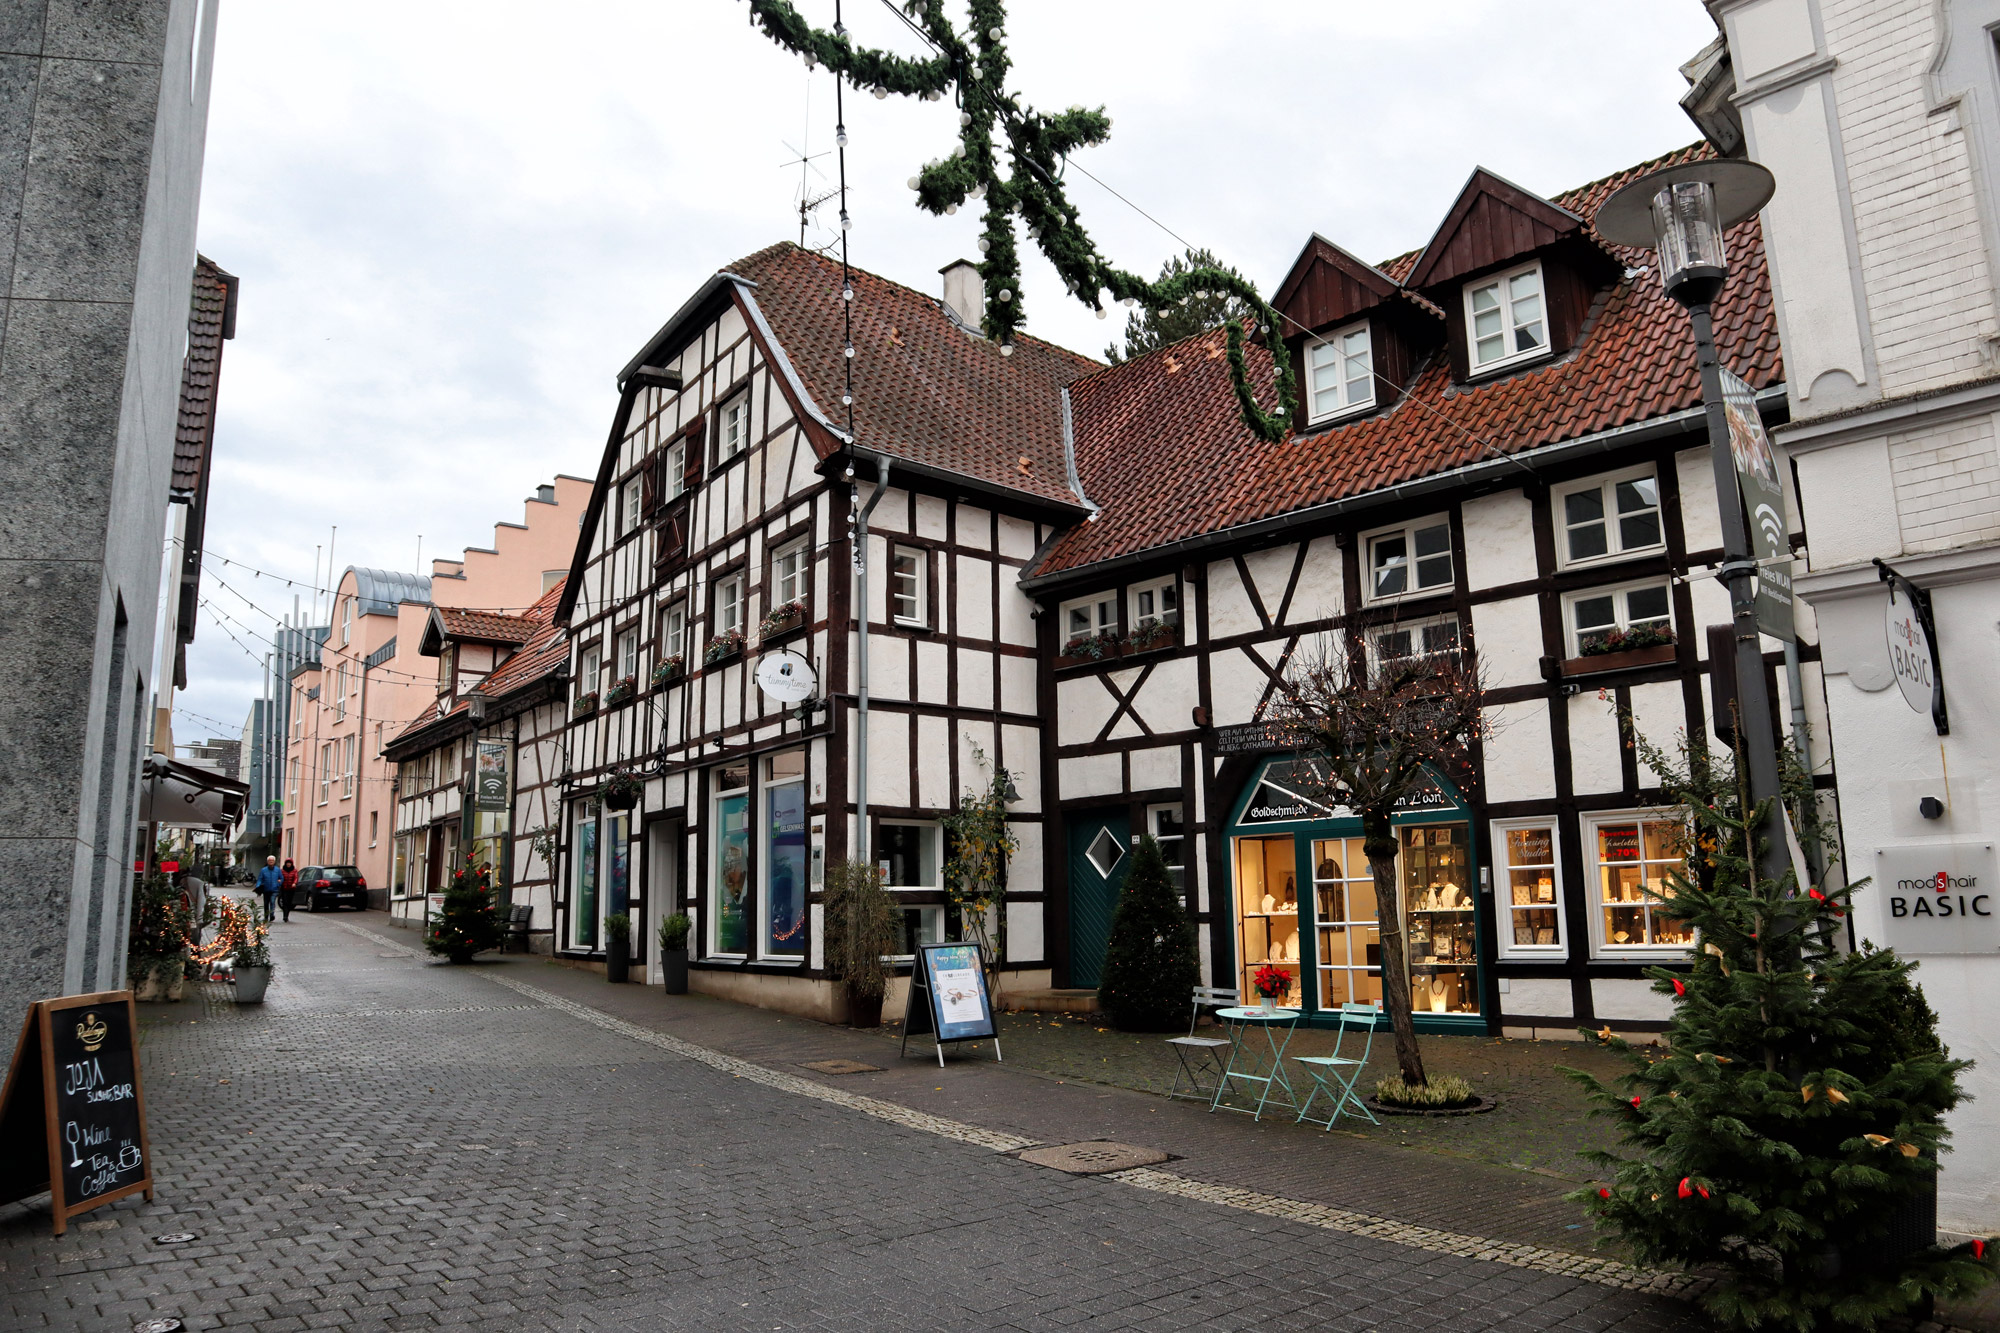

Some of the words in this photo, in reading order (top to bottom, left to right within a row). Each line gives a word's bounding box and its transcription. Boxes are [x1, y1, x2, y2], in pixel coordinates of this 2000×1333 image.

[1775, 570, 1791, 591] WLAN
[1894, 644, 1931, 688] BASIC
[766, 674, 807, 690] tummytime
[1251, 805, 1309, 818] Goldschmiede
[1599, 829, 1638, 838] Abverkauf
[1516, 847, 1549, 858] Studio
[1890, 894, 1991, 918] BASIC
[65, 1057, 104, 1095] JOJA
[111, 1083, 134, 1101] BAR
[82, 1123, 112, 1147] Wine
[87, 1153, 109, 1171] Tea
[81, 1169, 118, 1196] Coffee
